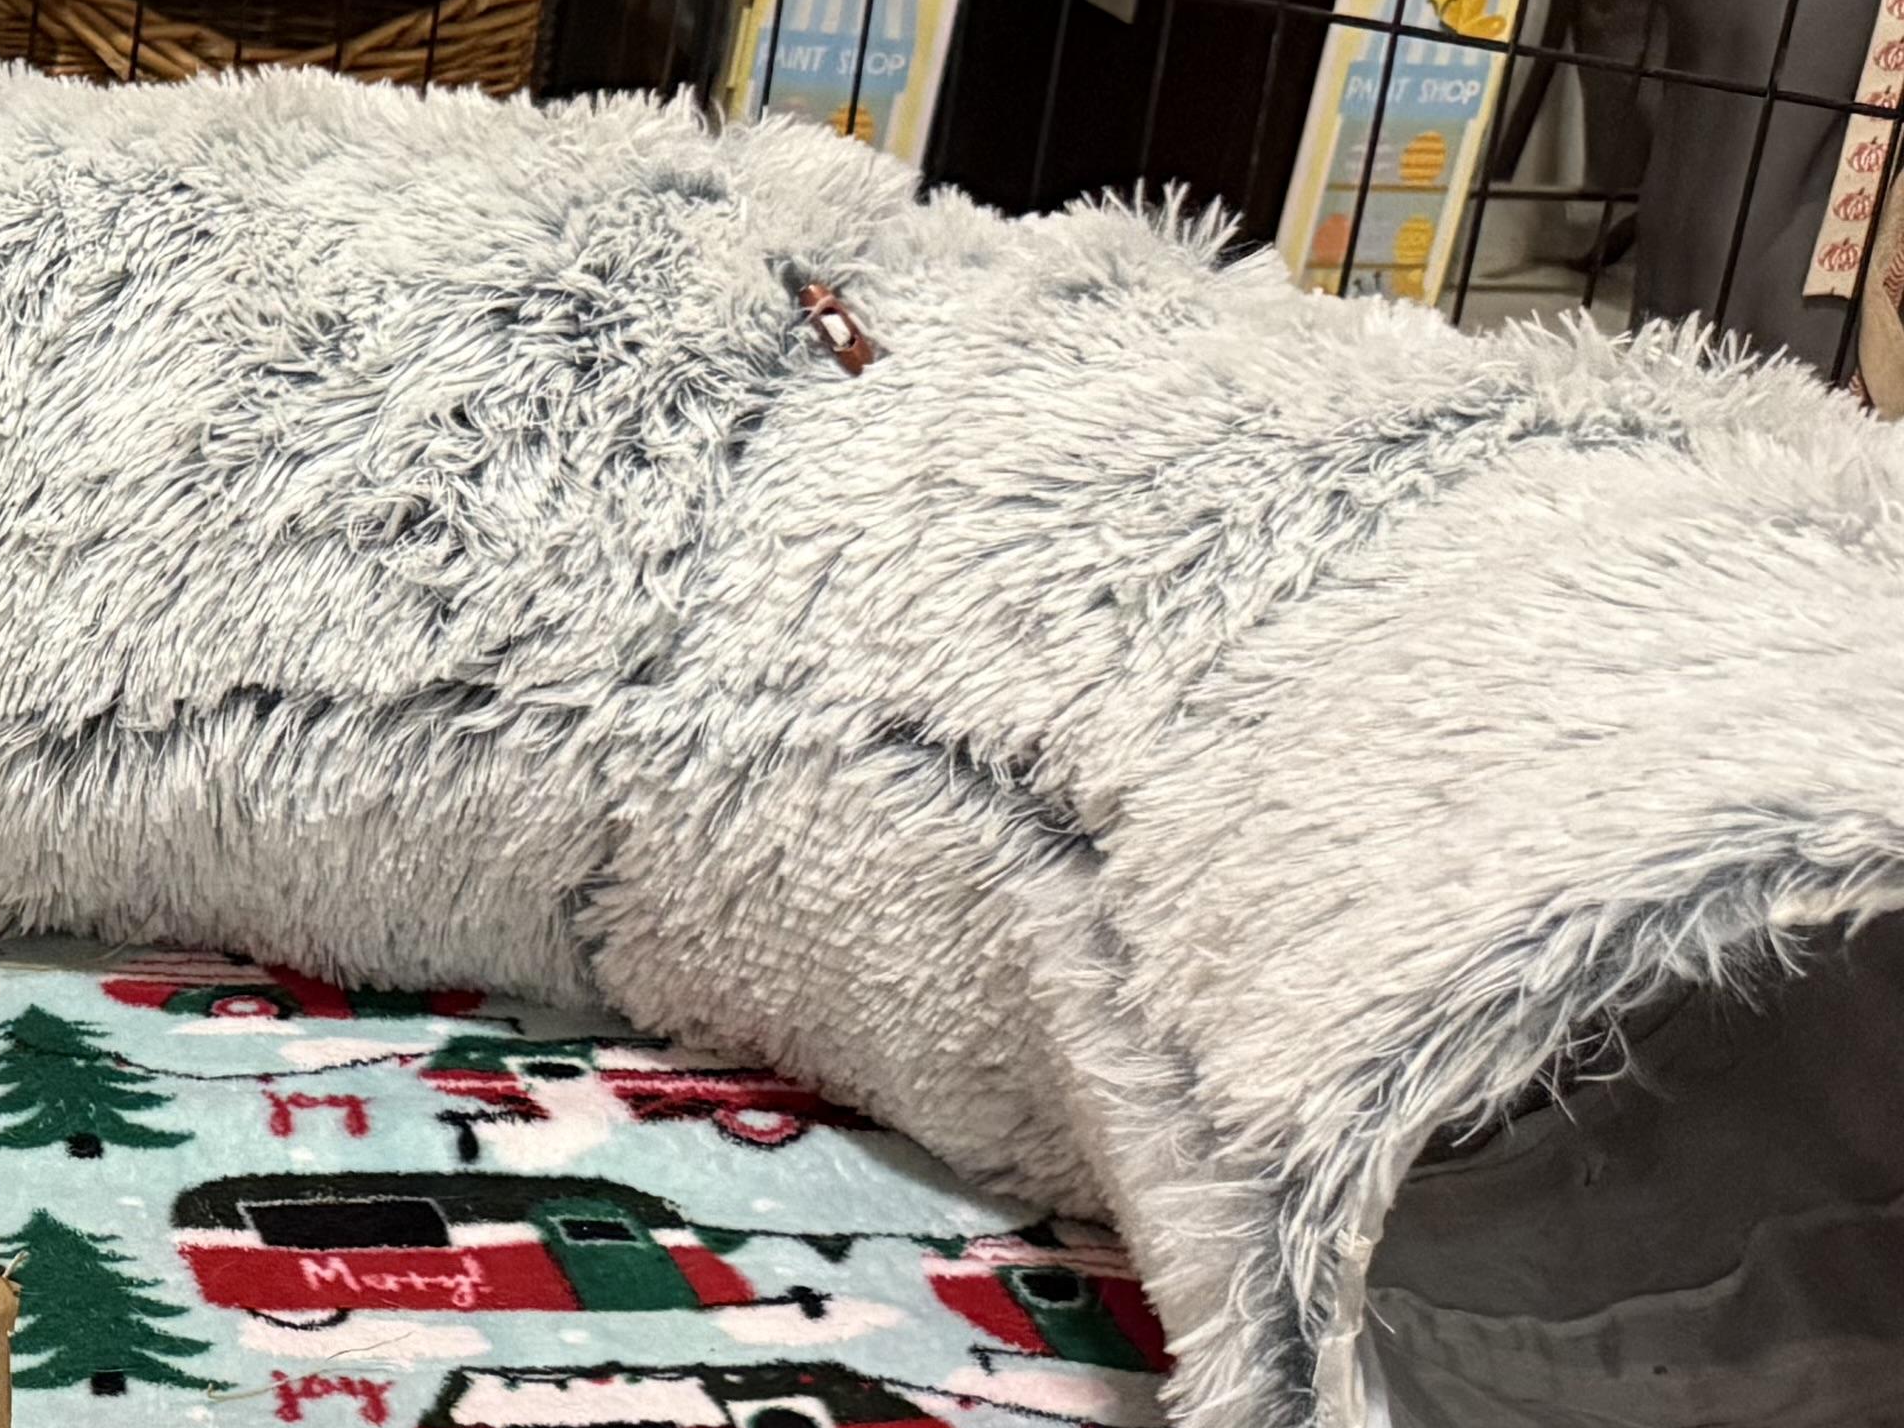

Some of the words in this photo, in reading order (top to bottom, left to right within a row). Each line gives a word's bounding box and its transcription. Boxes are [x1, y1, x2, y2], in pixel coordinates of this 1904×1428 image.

[268, 1092, 370, 1138] joy
[299, 1254, 492, 1307] Merry!
[272, 1369, 393, 1425] joy
